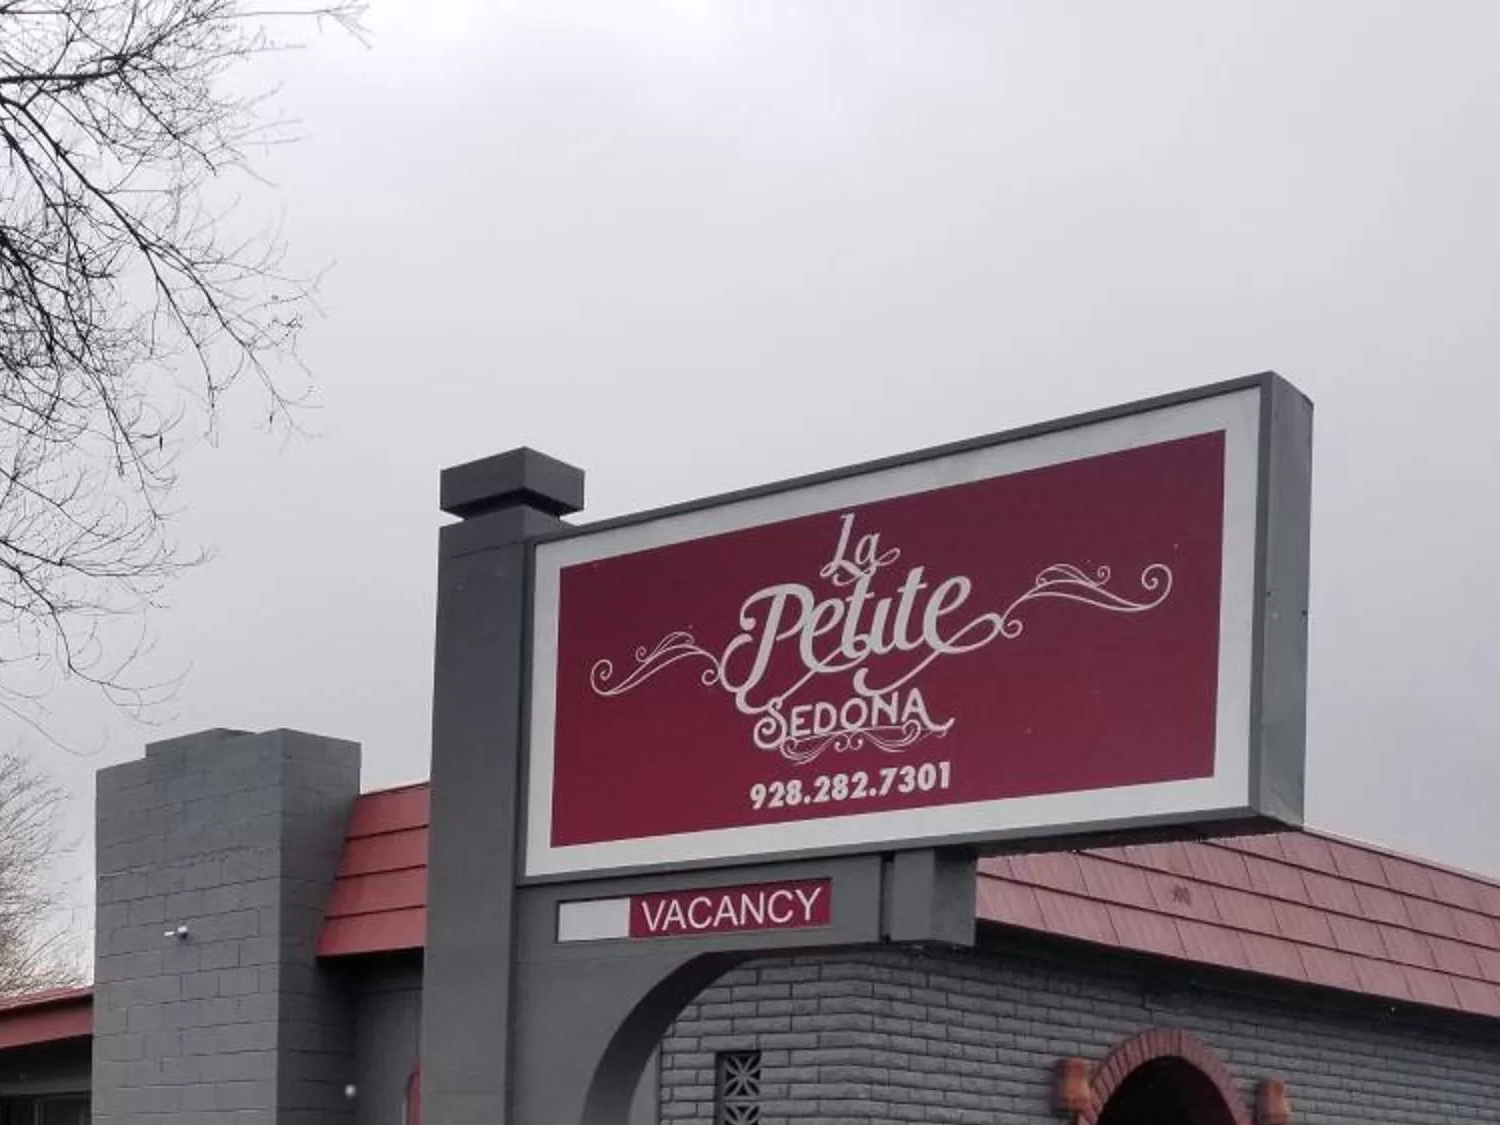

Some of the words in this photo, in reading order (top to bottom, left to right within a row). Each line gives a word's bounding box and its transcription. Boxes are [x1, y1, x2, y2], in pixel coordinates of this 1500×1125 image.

[819, 512, 900, 587] La
[719, 566, 1003, 714] Petite
[753, 688, 955, 750] SEDONA
[750, 760, 951, 810] 928.282.7301
[642, 887, 822, 932] VACANCY
